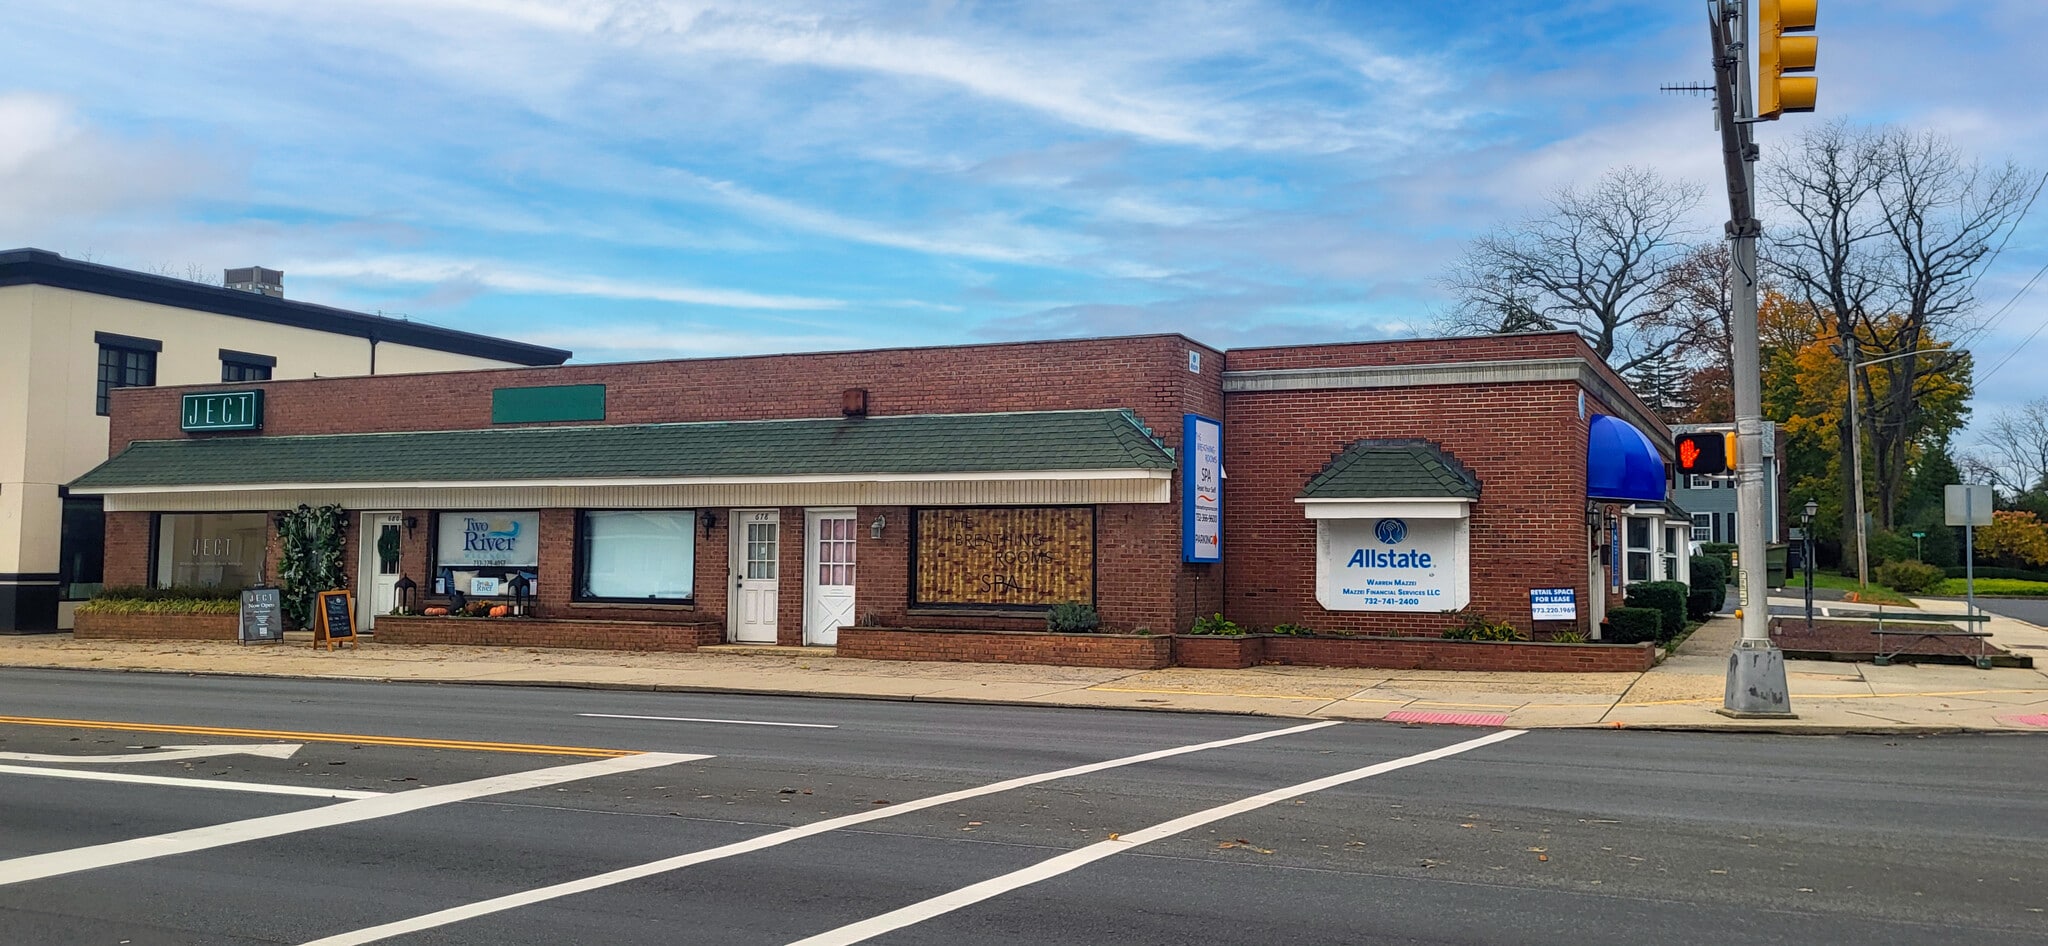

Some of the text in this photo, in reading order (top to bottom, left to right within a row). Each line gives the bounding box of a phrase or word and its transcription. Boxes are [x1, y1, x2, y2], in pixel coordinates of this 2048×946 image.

[189, 396, 248, 425] JECT
[1201, 467, 1212, 482] SPA
[463, 517, 489, 532] Two
[945, 516, 973, 529] THE
[193, 538, 232, 556] JECT
[463, 531, 516, 551] River
[955, 533, 1043, 548] BREATHING
[996, 551, 1054, 566] ROOMS
[1347, 549, 1432, 568] Allstate
[980, 574, 1021, 594] SPA
[249, 593, 272, 602] JECT
[1365, 597, 1419, 605] 732-741-2400
